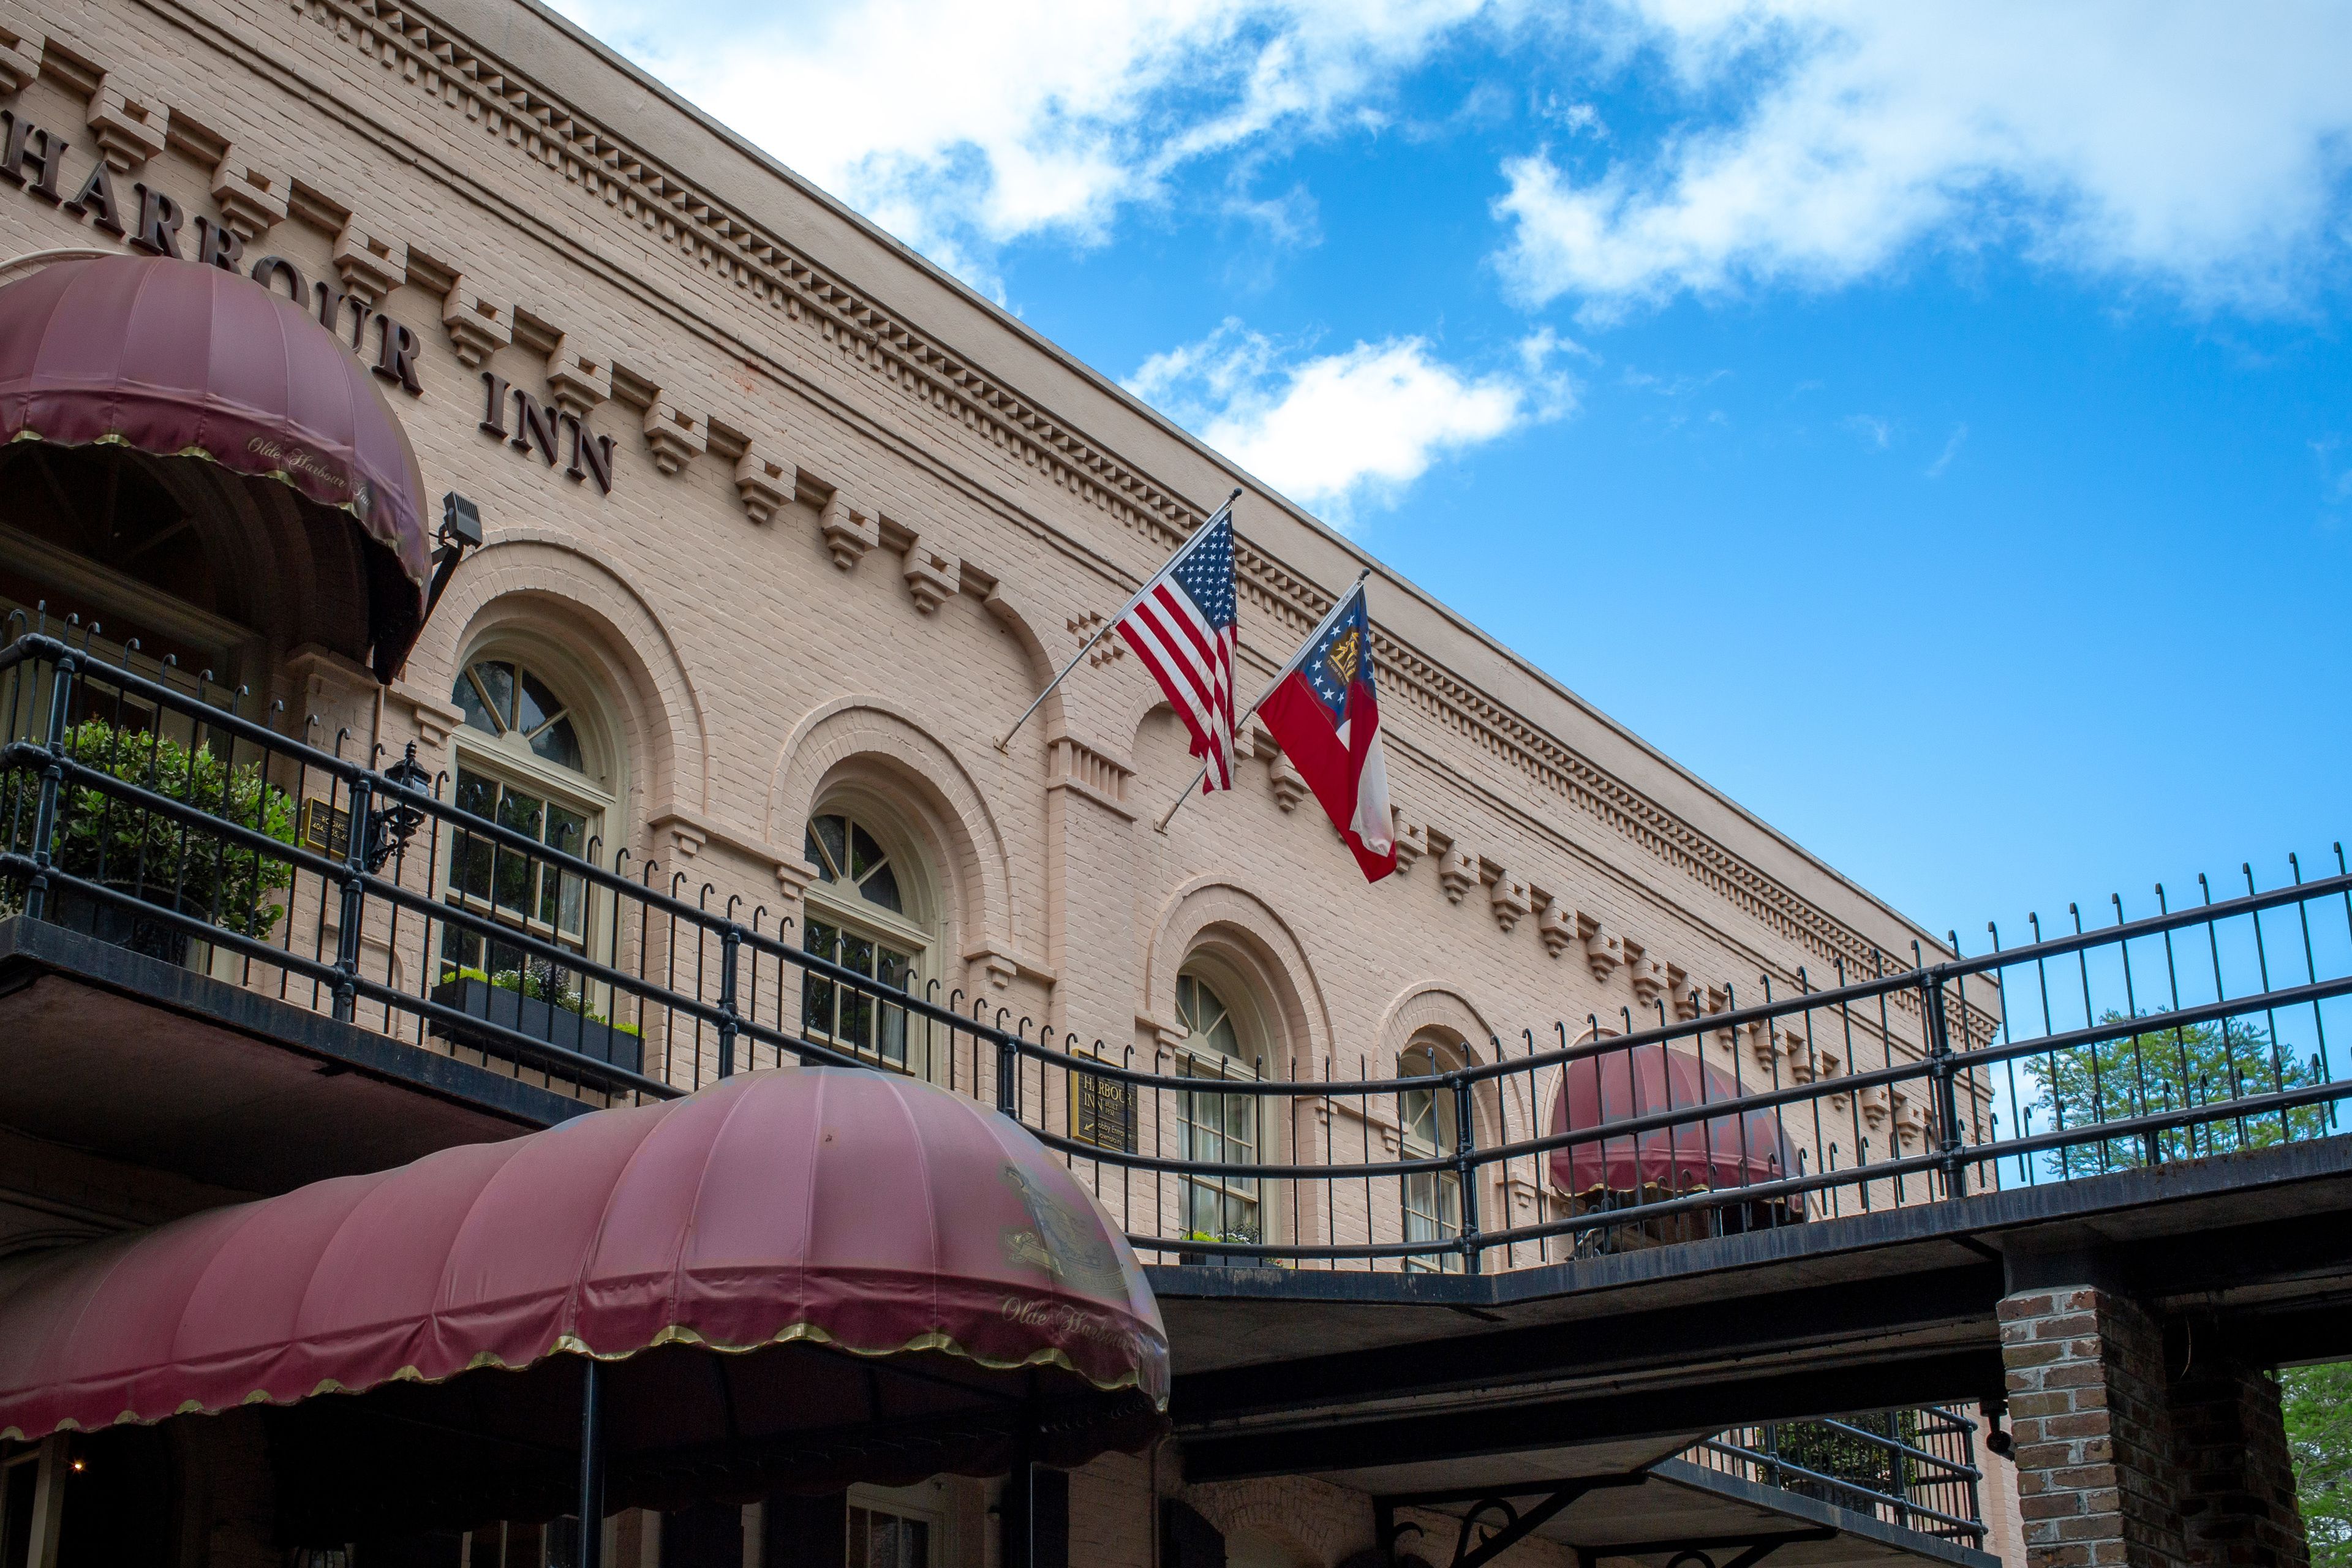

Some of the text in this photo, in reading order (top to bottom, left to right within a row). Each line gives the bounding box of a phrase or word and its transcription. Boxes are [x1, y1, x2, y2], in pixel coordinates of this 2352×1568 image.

[0, 109, 617, 495] HARBOUR INN
[247, 437, 372, 506] Olde Harbour Inn
[312, 822, 325, 833] 404,
[321, 816, 345, 831] ROOMS
[1084, 1075, 1132, 1106] HRBOUR
[1084, 1092, 1103, 1112] INN
[1105, 1101, 1118, 1110] BUILT
[1098, 1121, 1132, 1140] obby Entrae
[1001, 1297, 1133, 1349] Olde Harbour
